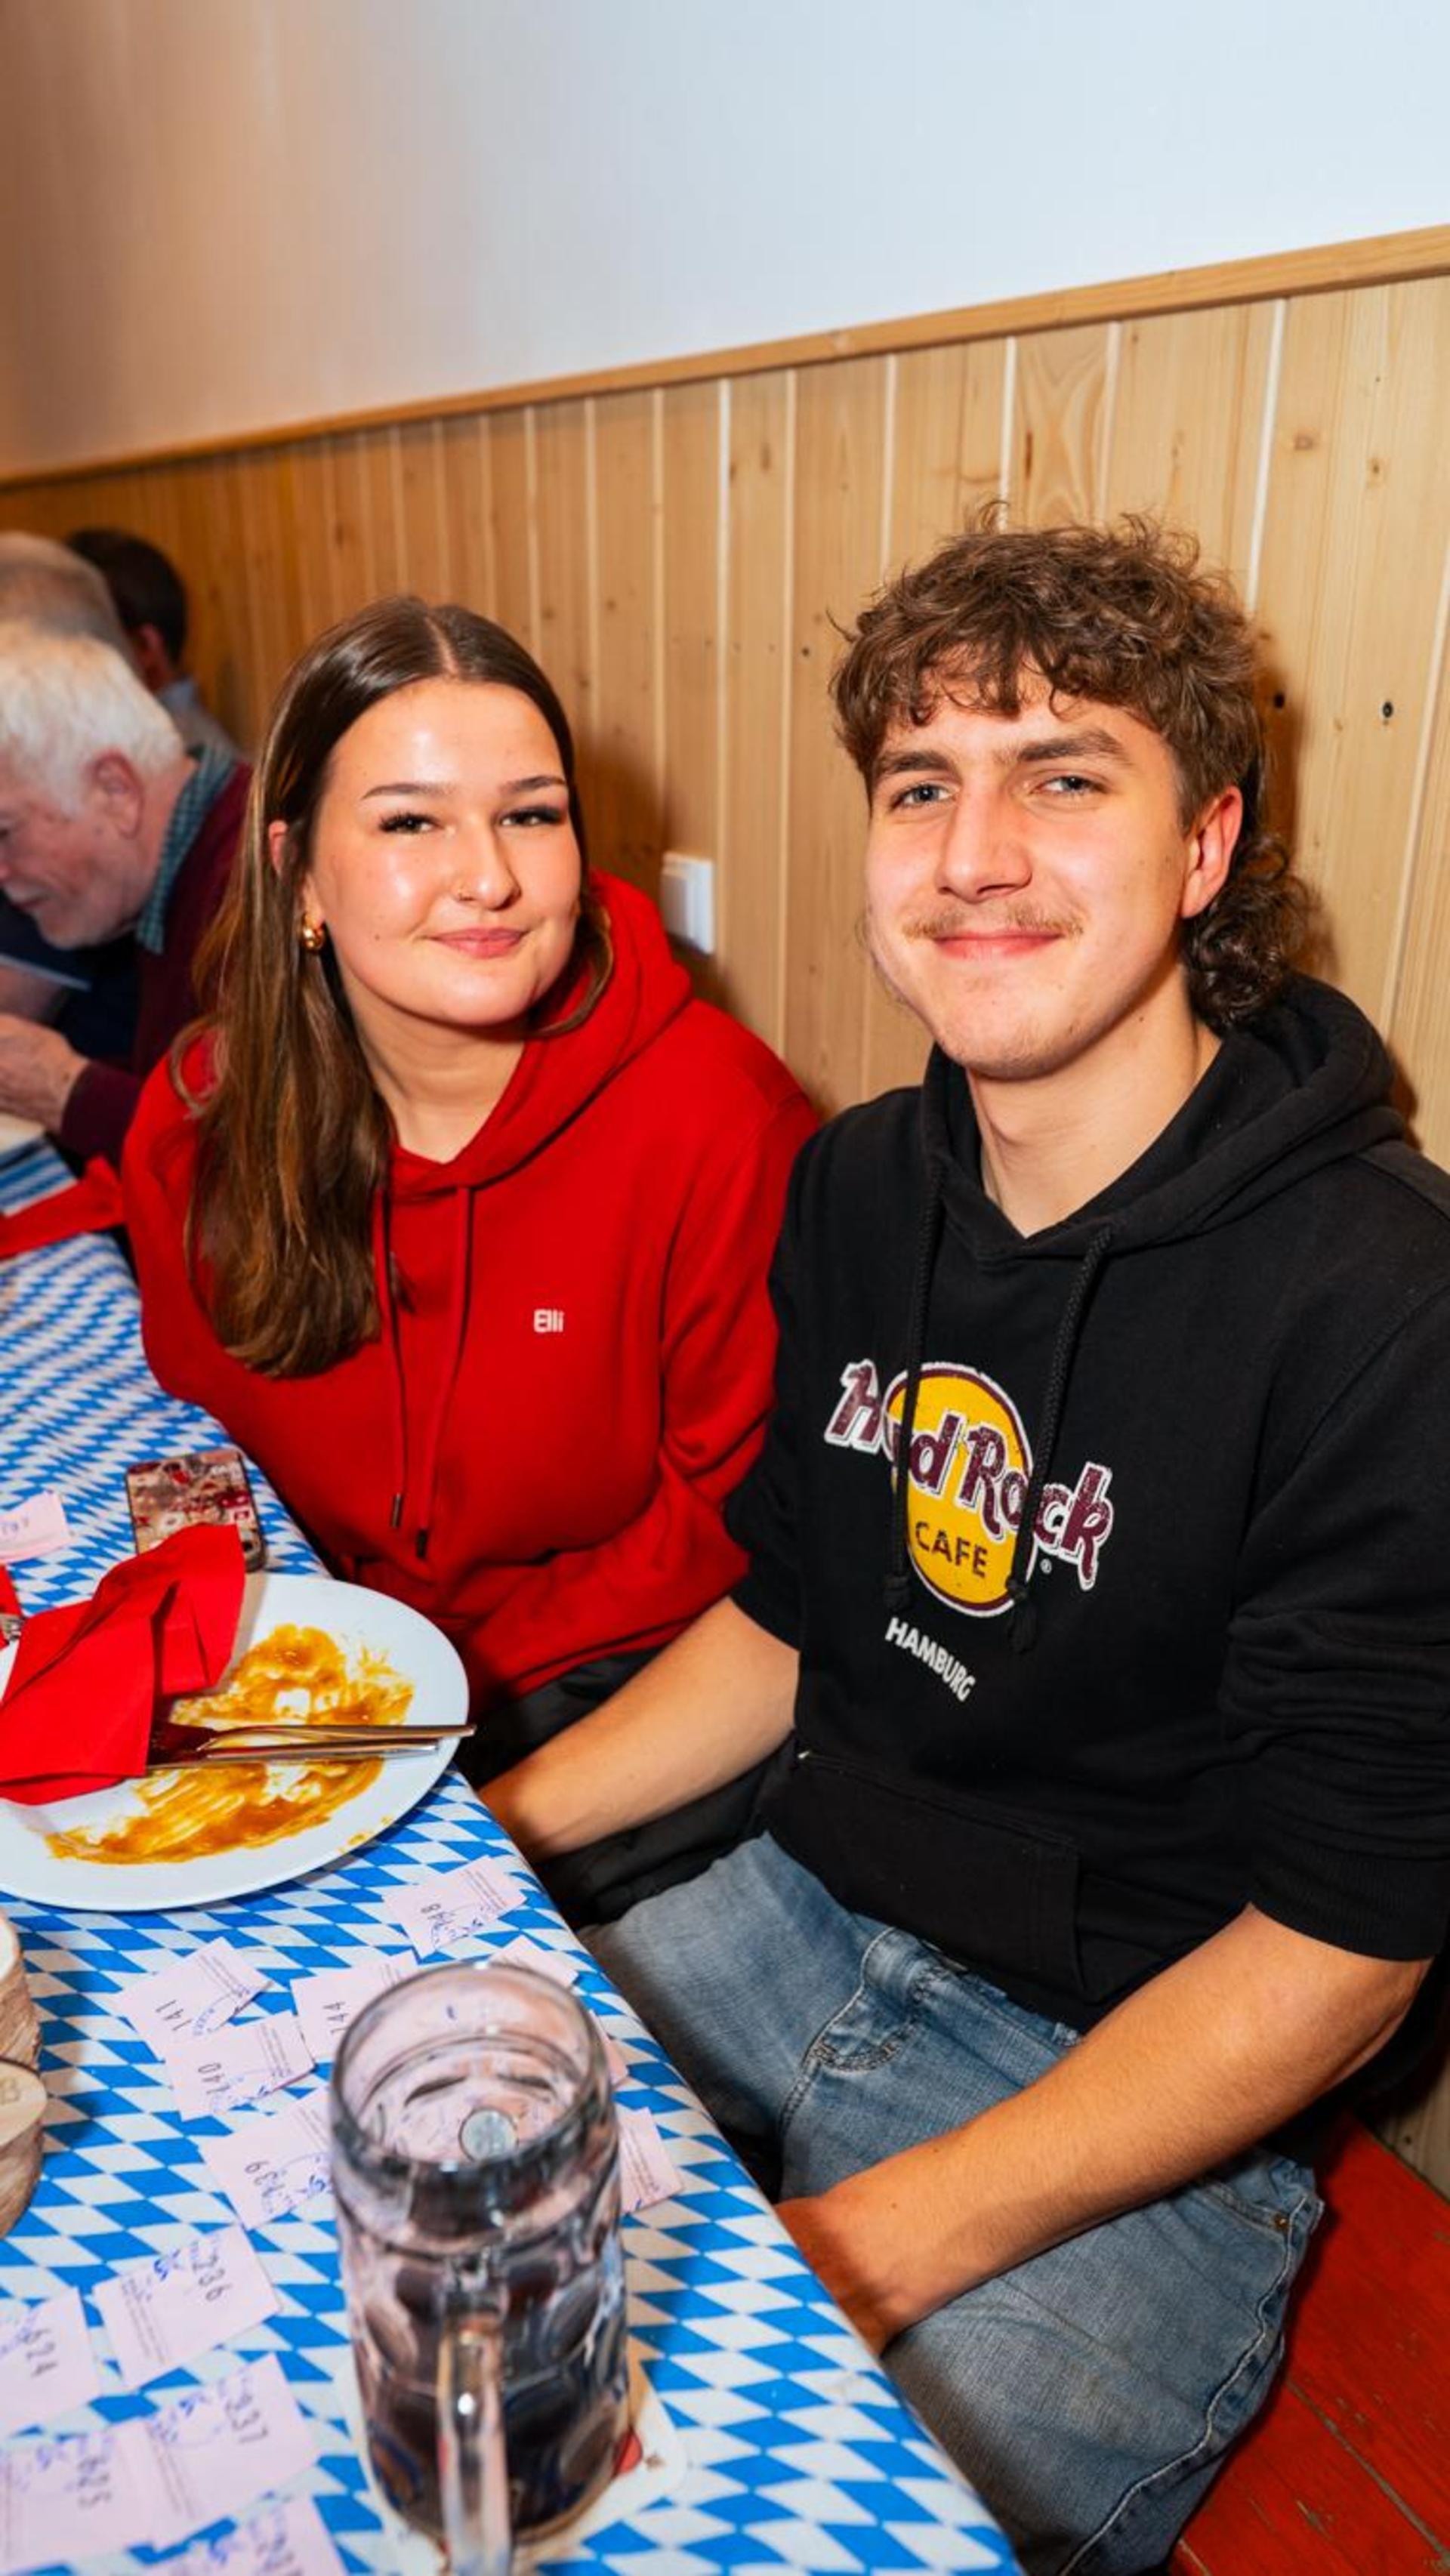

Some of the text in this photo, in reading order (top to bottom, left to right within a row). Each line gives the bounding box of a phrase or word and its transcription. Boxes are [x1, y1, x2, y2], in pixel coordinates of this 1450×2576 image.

[533, 1308, 565, 1333] Elli
[955, 1423, 1114, 1591] Rock
[915, 1520, 989, 1579] CAFE
[884, 1616, 976, 1702] HAMBURG
[155, 2000, 193, 2031] 141
[197, 2062, 230, 2095] 140
[192, 2253, 233, 2302] 236
